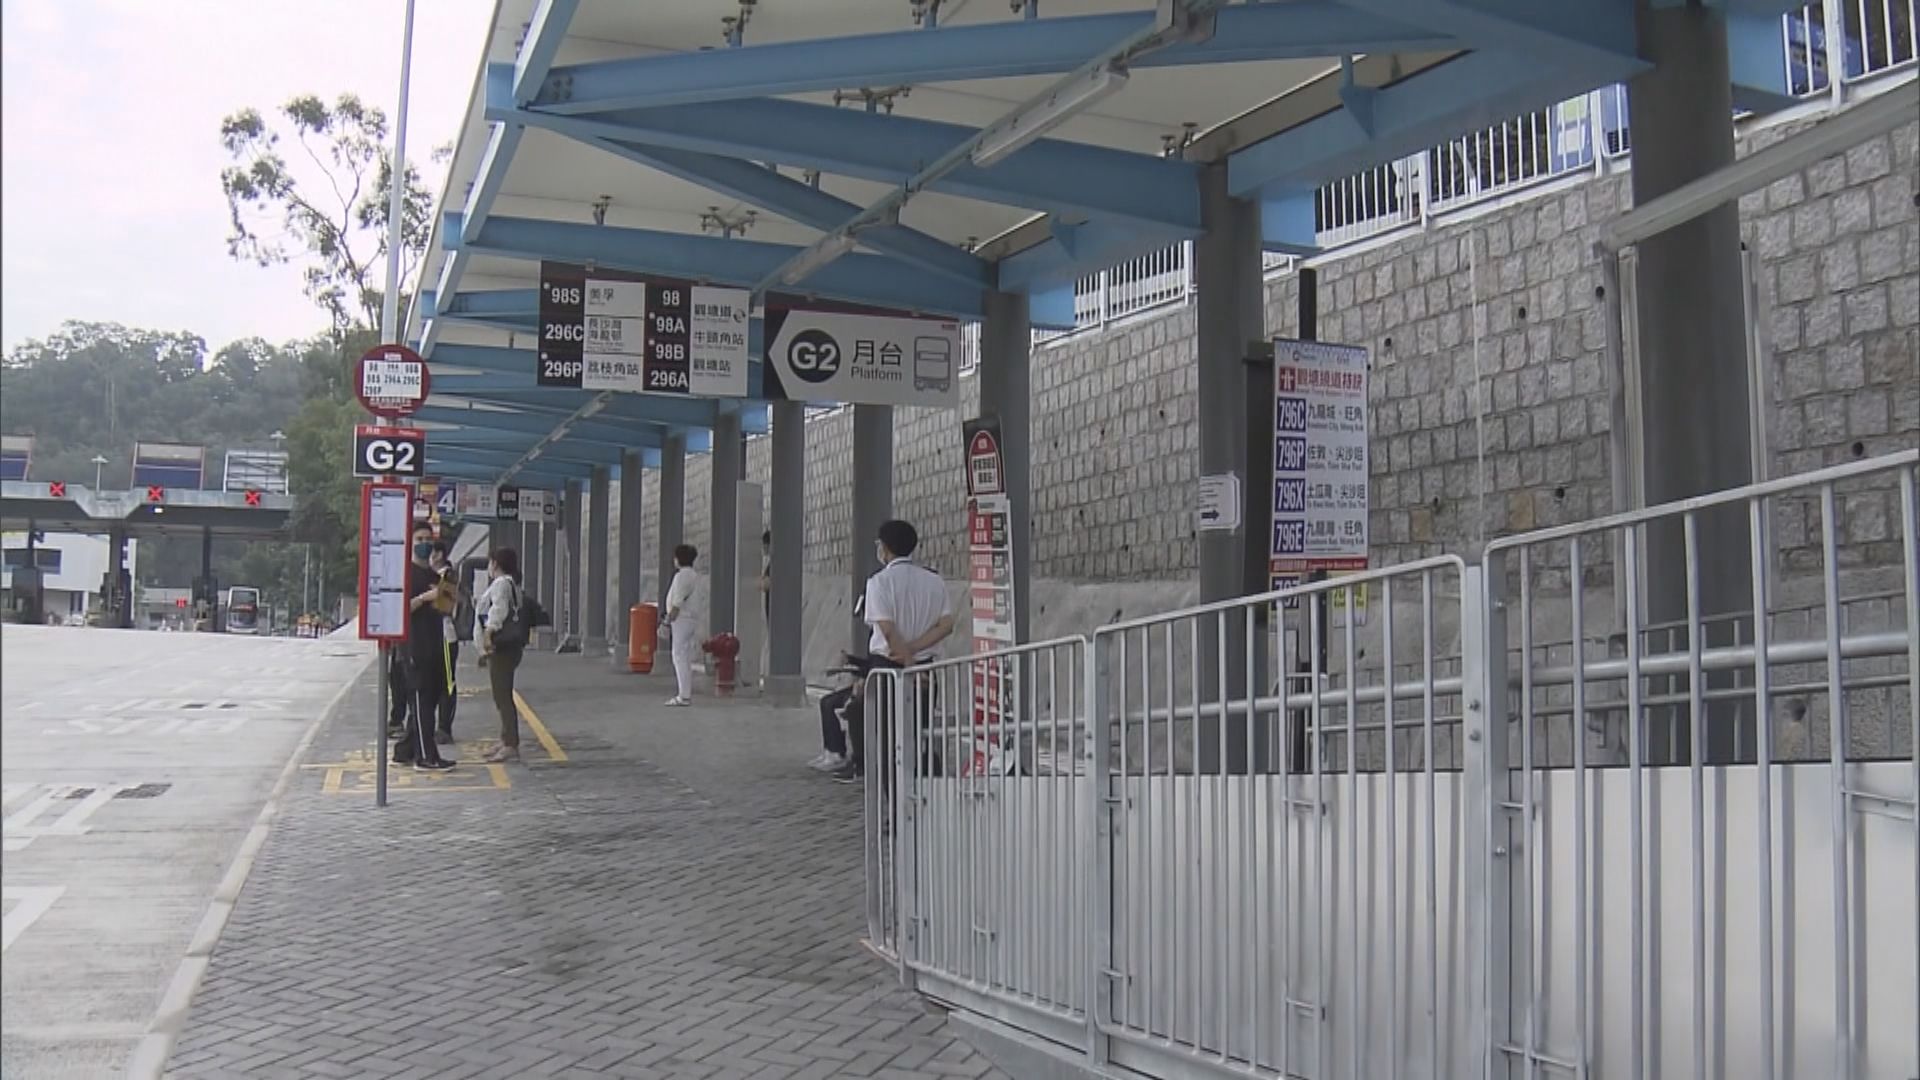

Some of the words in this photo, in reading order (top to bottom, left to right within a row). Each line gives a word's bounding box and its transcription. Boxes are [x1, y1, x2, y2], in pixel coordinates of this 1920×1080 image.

[551, 288, 580, 304] 98S
[662, 290, 680, 306] 98
[546, 324, 583, 341] 296C
[656, 317, 685, 333] 98A
[694, 331, 744, 345] 牛頭角站
[655, 344, 684, 361] 98B
[791, 342, 837, 371] G2
[852, 340, 903, 366] 月台
[544, 361, 582, 378] 296P
[851, 366, 903, 381] Platform
[651, 371, 688, 388] 296A
[1279, 400, 1305, 429] 796C
[366, 440, 415, 471] G2
[1278, 440, 1304, 468] 796P
[1277, 481, 1304, 510] 796X
[1276, 523, 1303, 551] 796E
